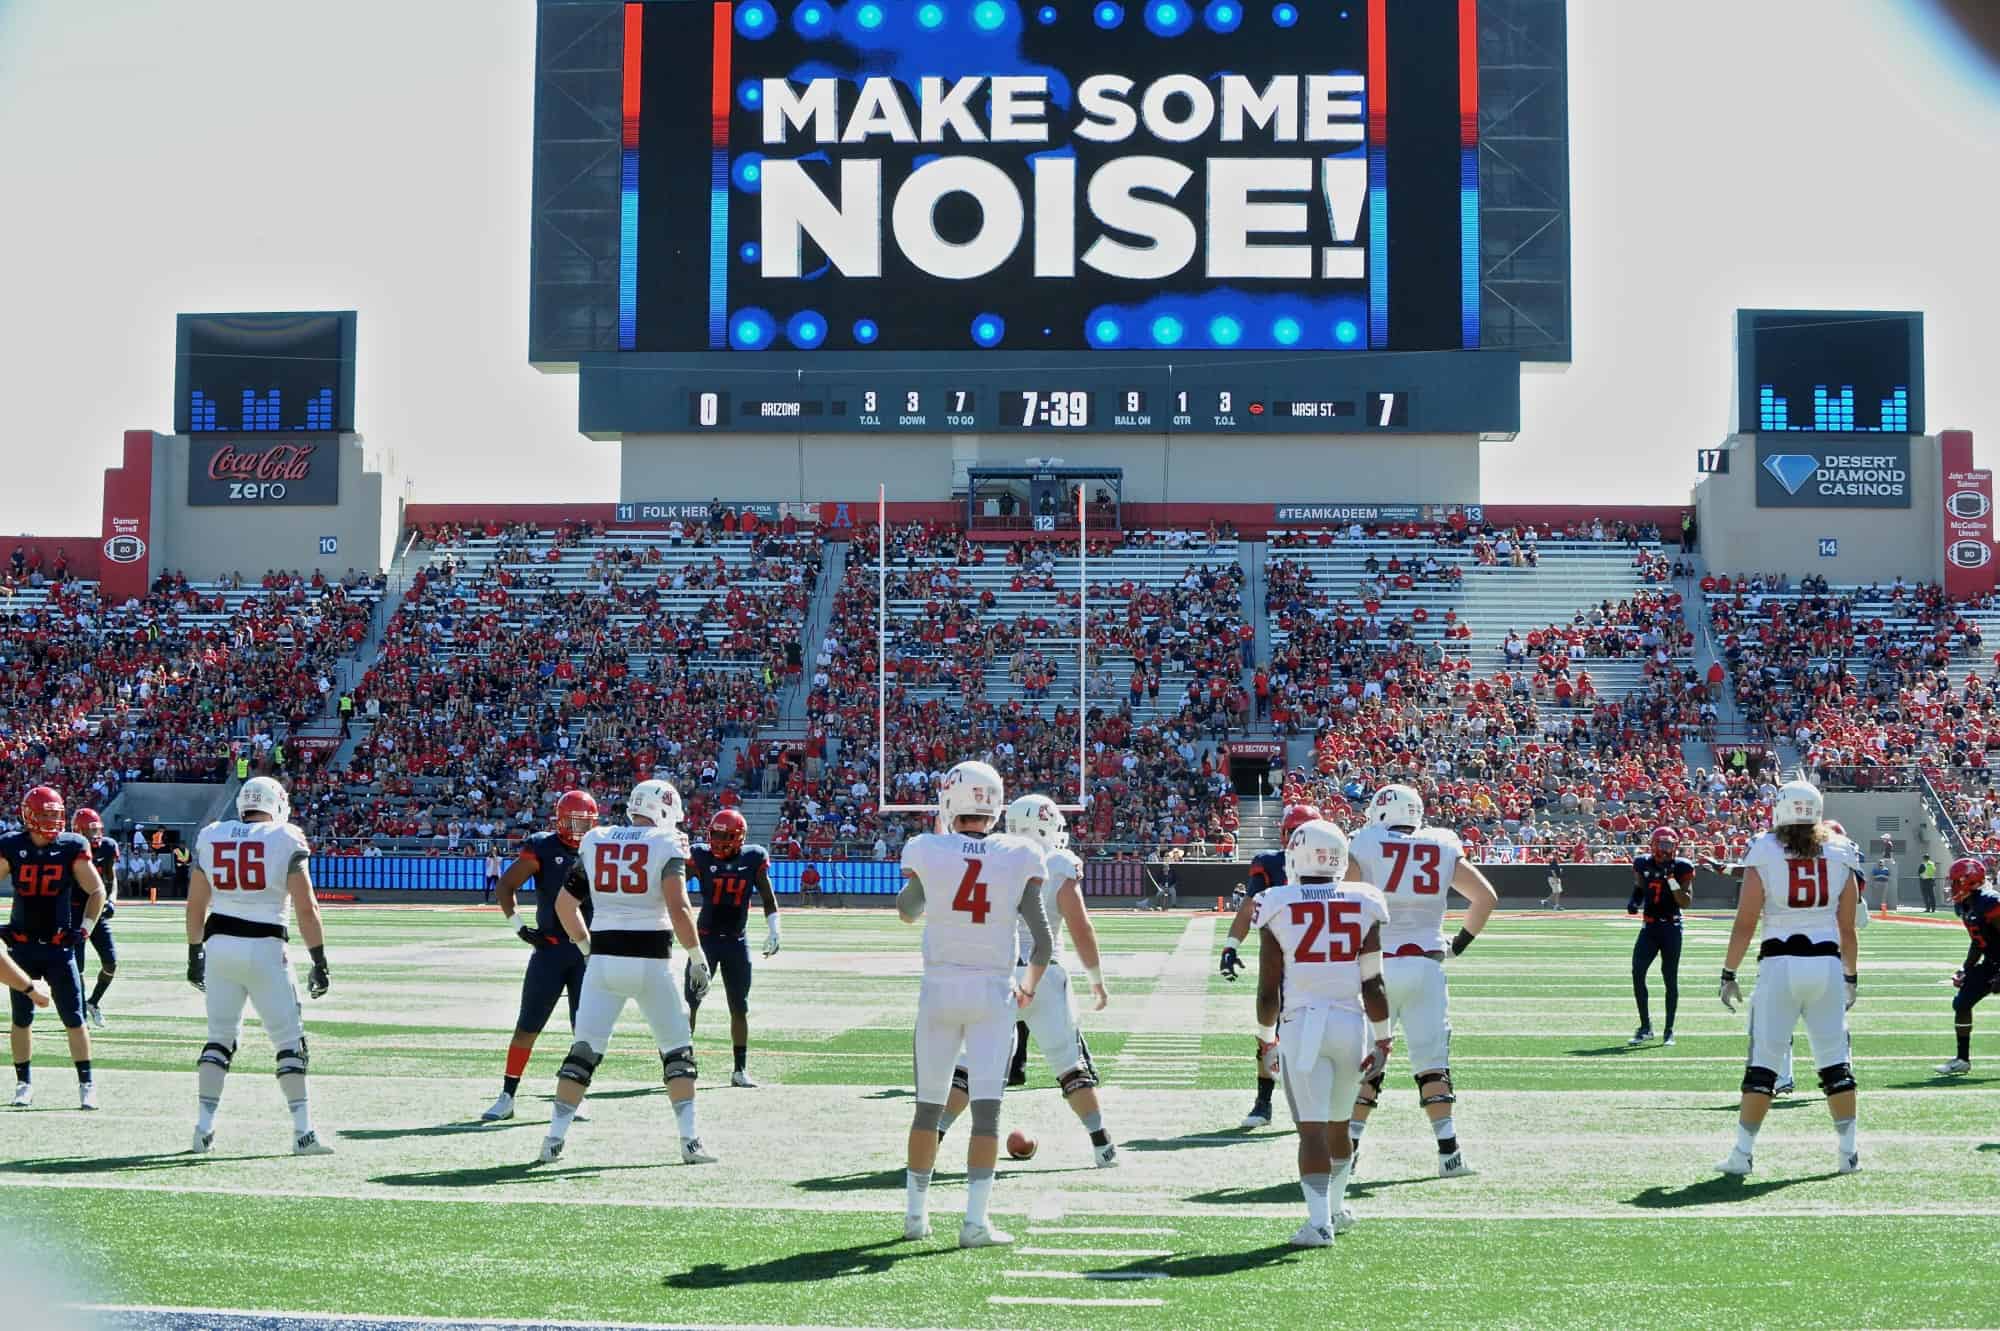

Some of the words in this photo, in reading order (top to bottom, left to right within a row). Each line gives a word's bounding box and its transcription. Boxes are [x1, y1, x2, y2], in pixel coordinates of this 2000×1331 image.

[761, 75, 1049, 144] MAKE
[1073, 75, 1365, 144] SOME
[759, 155, 1367, 279] NOISE!
[700, 393, 718, 426] 0
[761, 402, 800, 417] ARIZONA
[865, 391, 876, 412] 3
[907, 391, 918, 412] 3
[956, 391, 966, 412] 7
[1022, 391, 1088, 427] 7:39
[1127, 391, 1139, 412] 9
[1178, 391, 1187, 412] 1
[1220, 391, 1231, 412] 3
[1291, 402, 1317, 417] WASH
[1319, 402, 1336, 417] ST.
[1379, 393, 1394, 426] 7
[899, 416, 926, 425] DOWN
[947, 416, 958, 425] TO
[961, 416, 975, 425] GO
[1114, 416, 1137, 425] BALL
[1139, 416, 1151, 425] ON
[1173, 416, 1191, 425] QTR
[1701, 451, 1721, 472] 17
[1825, 456, 1897, 468] DESERT
[1816, 469, 1906, 482] DIAMOND
[229, 482, 286, 499] zero
[1818, 483, 1903, 496] CASINOS
[619, 506, 633, 519] 11
[642, 505, 678, 518] FOLK
[1279, 507, 1378, 519] #TEAMKADEEM
[1465, 507, 1481, 520] 13
[1035, 516, 1054, 530] 12
[319, 538, 337, 552] 10
[1818, 540, 1836, 554] 14
[963, 842, 987, 855] FALK
[210, 841, 267, 891] 56
[594, 843, 649, 894] 63
[1379, 842, 1441, 895] 73
[17, 864, 63, 897] 92
[952, 858, 991, 924] 4
[1785, 858, 1829, 909] 61
[712, 878, 747, 905] 14
[1287, 901, 1362, 963] 25
